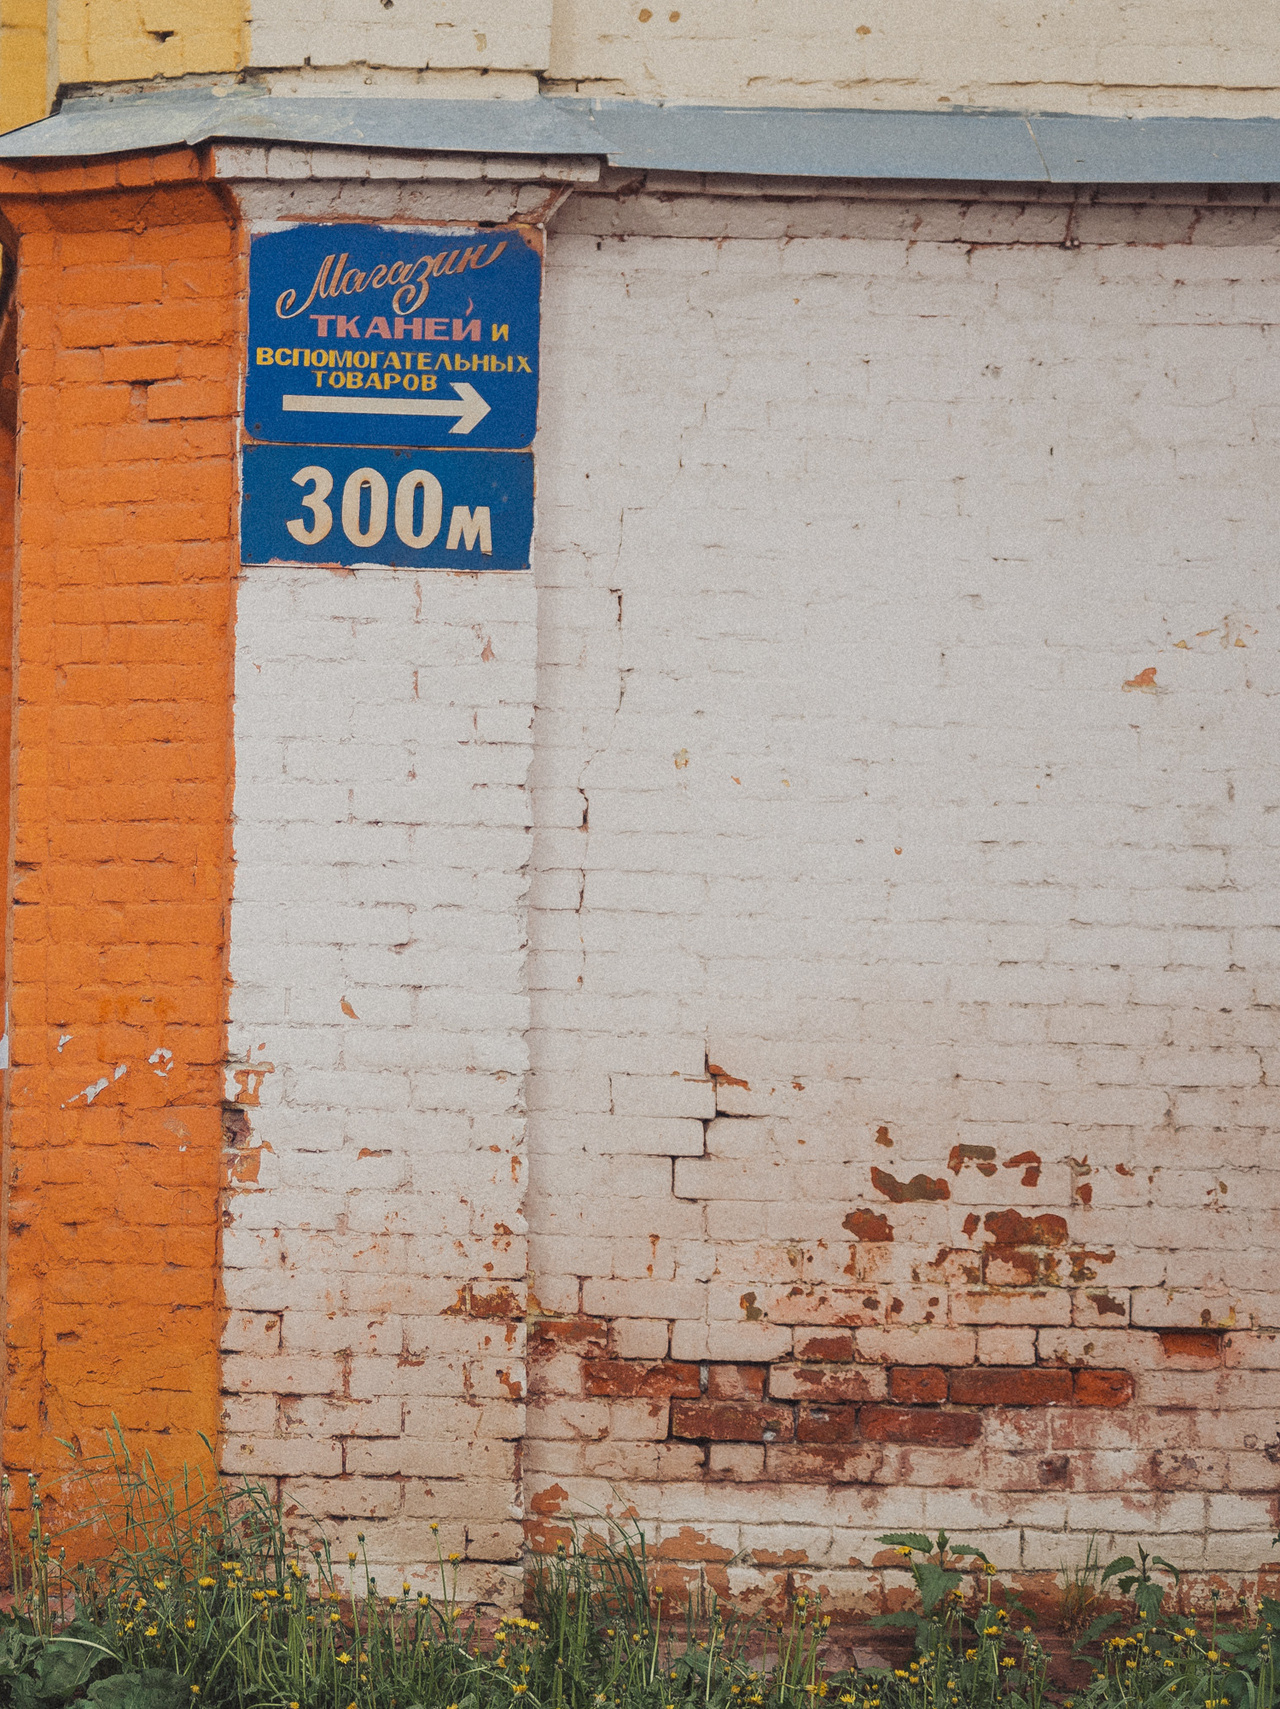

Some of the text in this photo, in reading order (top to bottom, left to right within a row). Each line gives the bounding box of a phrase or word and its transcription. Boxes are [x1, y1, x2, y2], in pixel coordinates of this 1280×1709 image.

[275, 241, 509, 320] Магазин
[309, 298, 482, 342] ТКАНЕЙ
[256, 346, 533, 374] ВСПОМОГАТЕЛЬНЫХ
[311, 370, 438, 392] ТОВАРОВ
